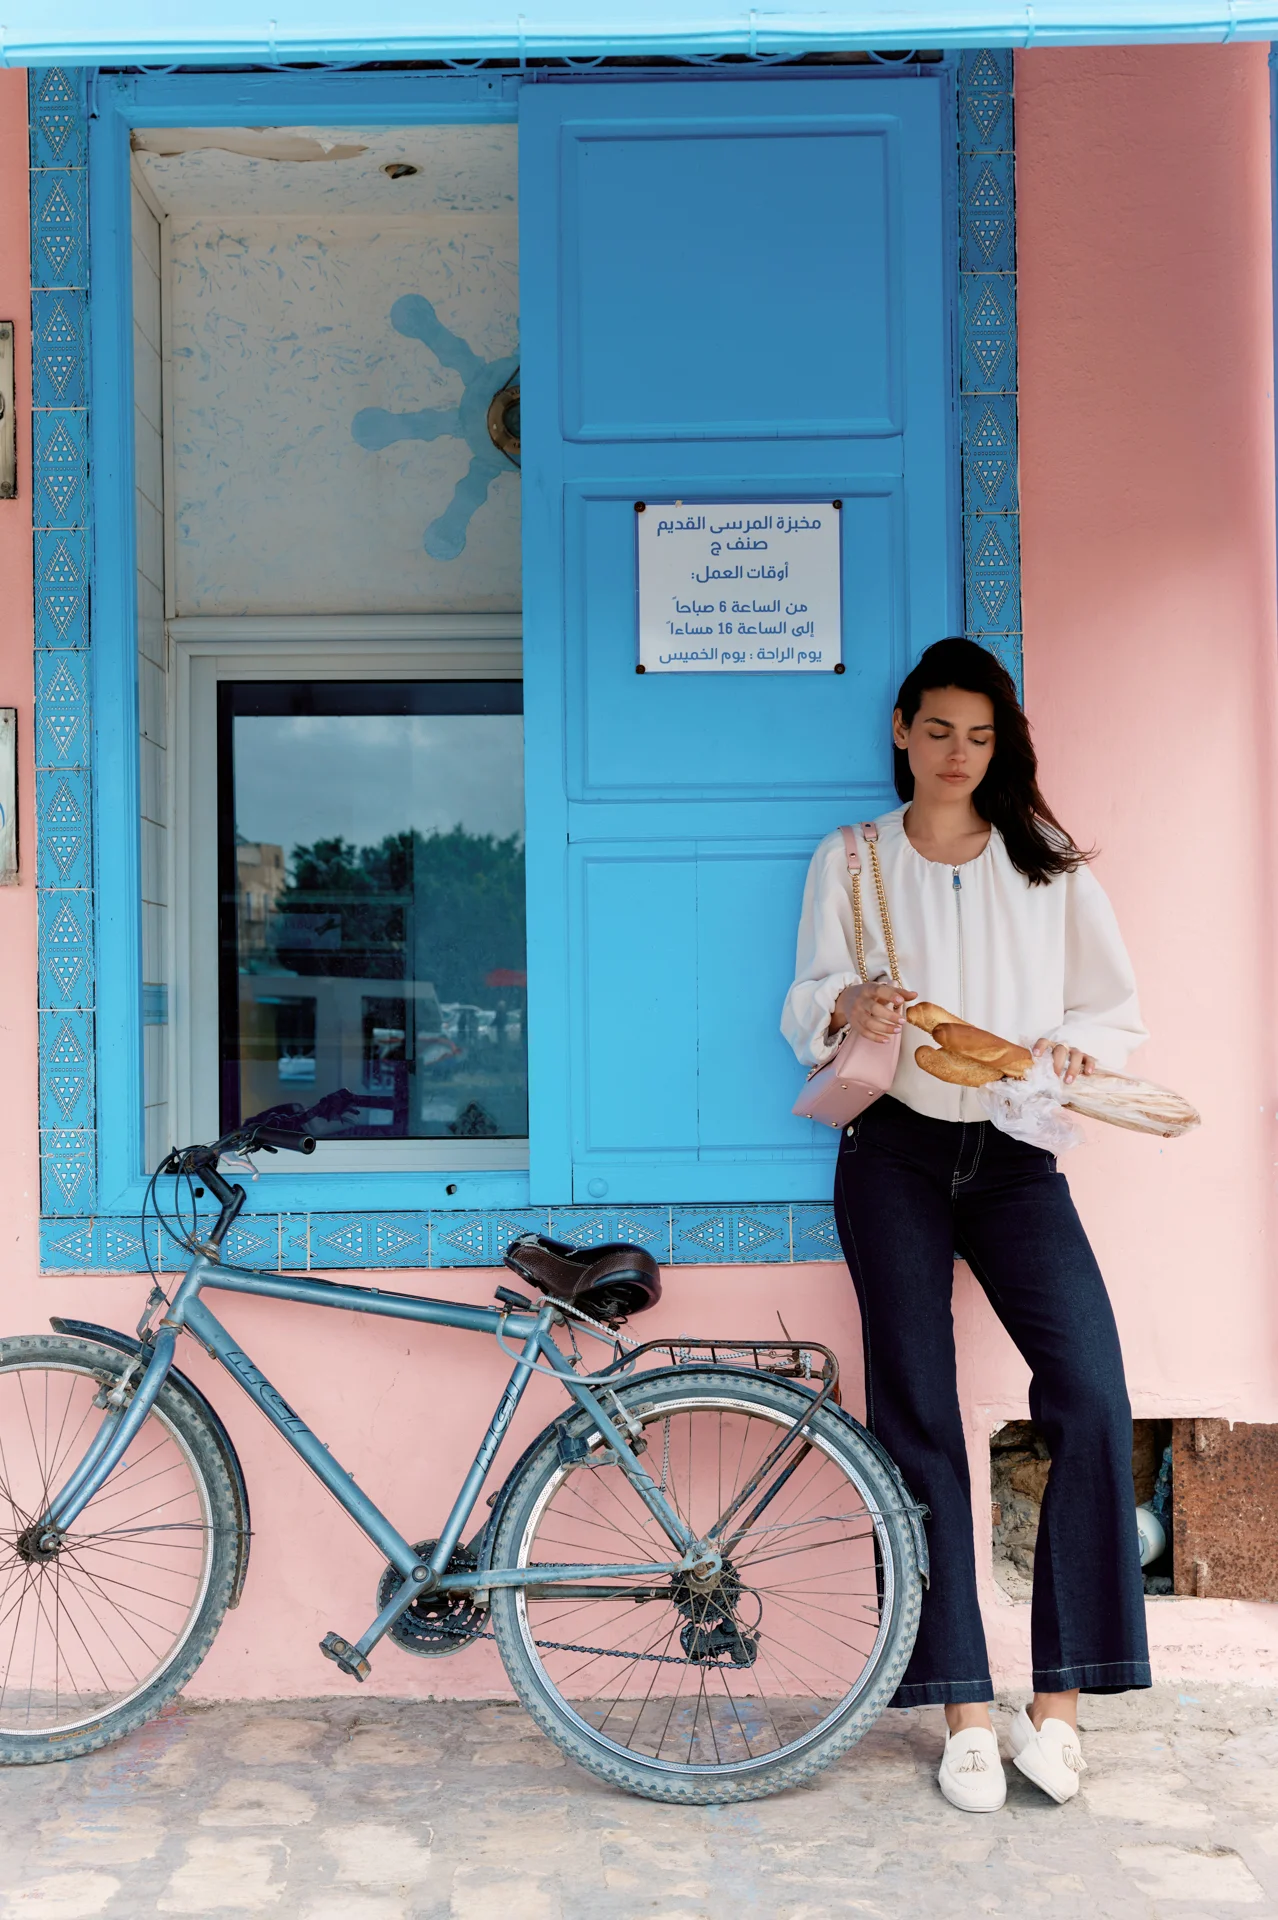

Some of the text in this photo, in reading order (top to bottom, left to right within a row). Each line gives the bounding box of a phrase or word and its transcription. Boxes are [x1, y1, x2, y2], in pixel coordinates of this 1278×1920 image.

[657, 516, 821, 537] مخبزة المرسى القديم
[711, 537, 768, 556] صنف ج
[691, 561, 789, 583] أوقات العمل:
[719, 601, 726, 612] 6
[732, 600, 780, 613] الساعة
[785, 604, 808, 615] من
[718, 622, 733, 634] 16
[738, 621, 786, 634] الساعة
[791, 622, 814, 638] إلى
[659, 648, 718, 664] الخميس
[722, 652, 746, 664] يوم
[757, 647, 794, 662] الراحة
[797, 650, 822, 665] يوم
